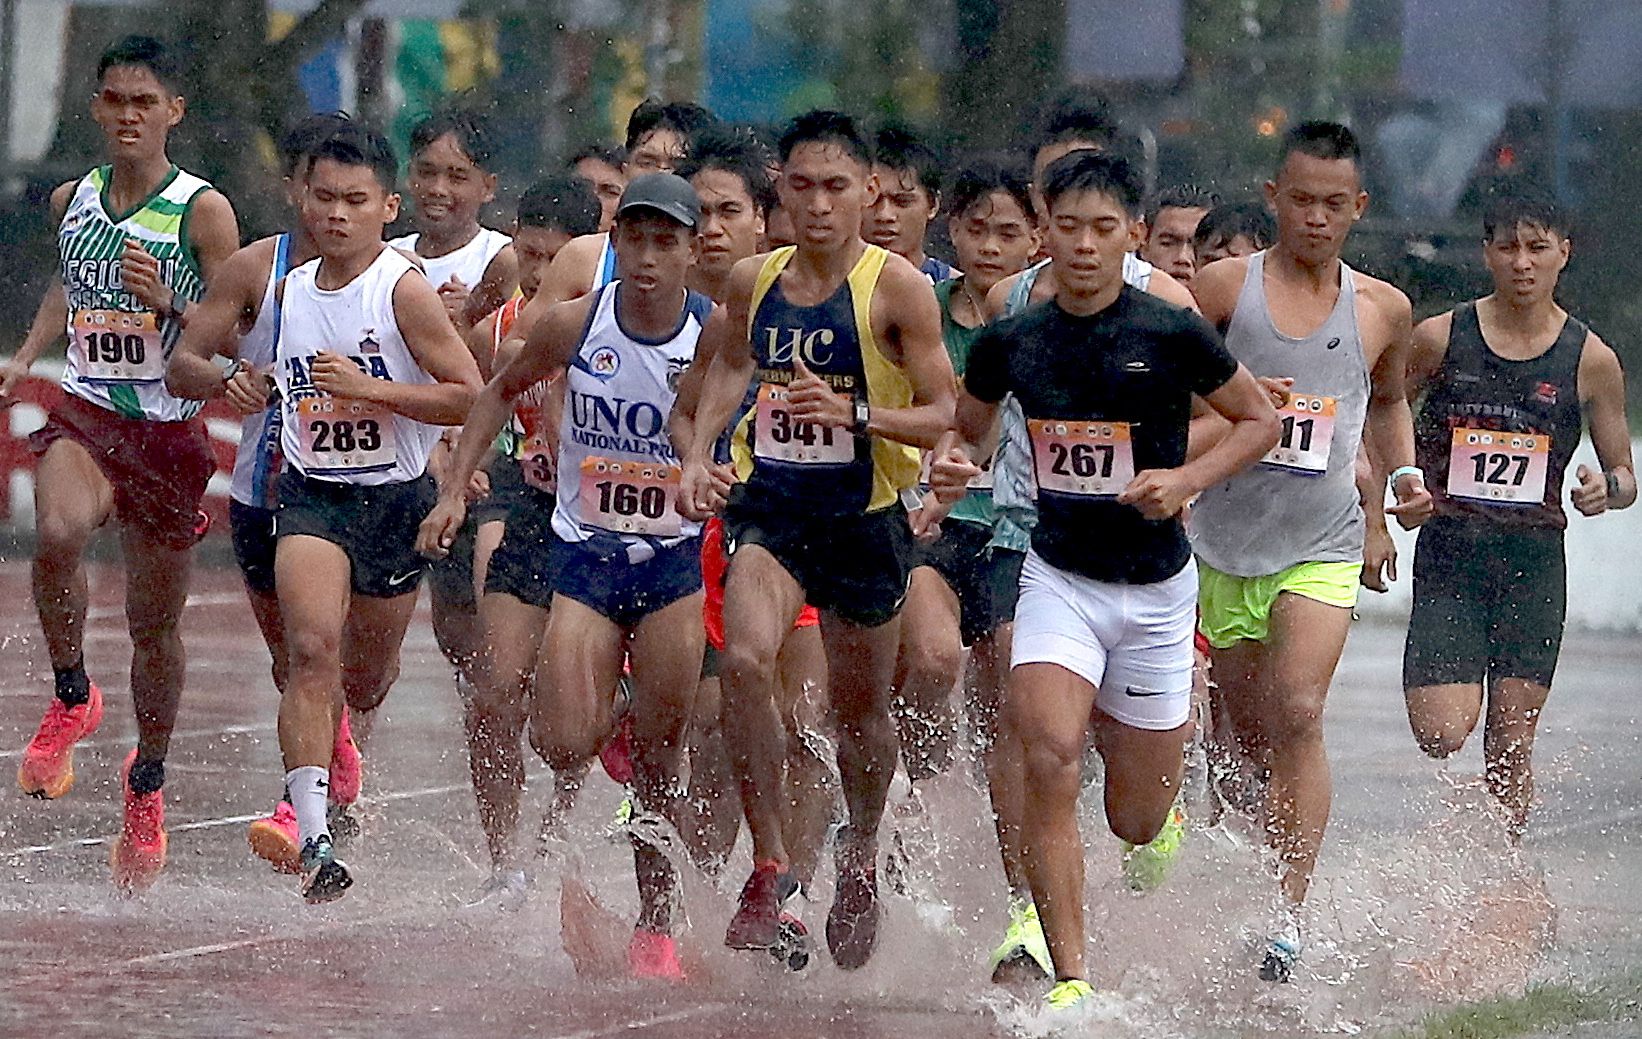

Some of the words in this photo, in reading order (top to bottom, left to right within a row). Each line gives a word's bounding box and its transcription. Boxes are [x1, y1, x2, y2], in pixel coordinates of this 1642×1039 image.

[63, 258, 124, 290] EGIO
[84, 332, 145, 365] 190
[765, 327, 834, 366] UC
[571, 390, 663, 439] UNO
[771, 409, 833, 446] 341
[310, 419, 382, 453] 283
[572, 427, 646, 454] NATIONAL
[1049, 443, 1115, 478] 267
[1470, 452, 1530, 486] 127
[595, 481, 666, 519] 160
